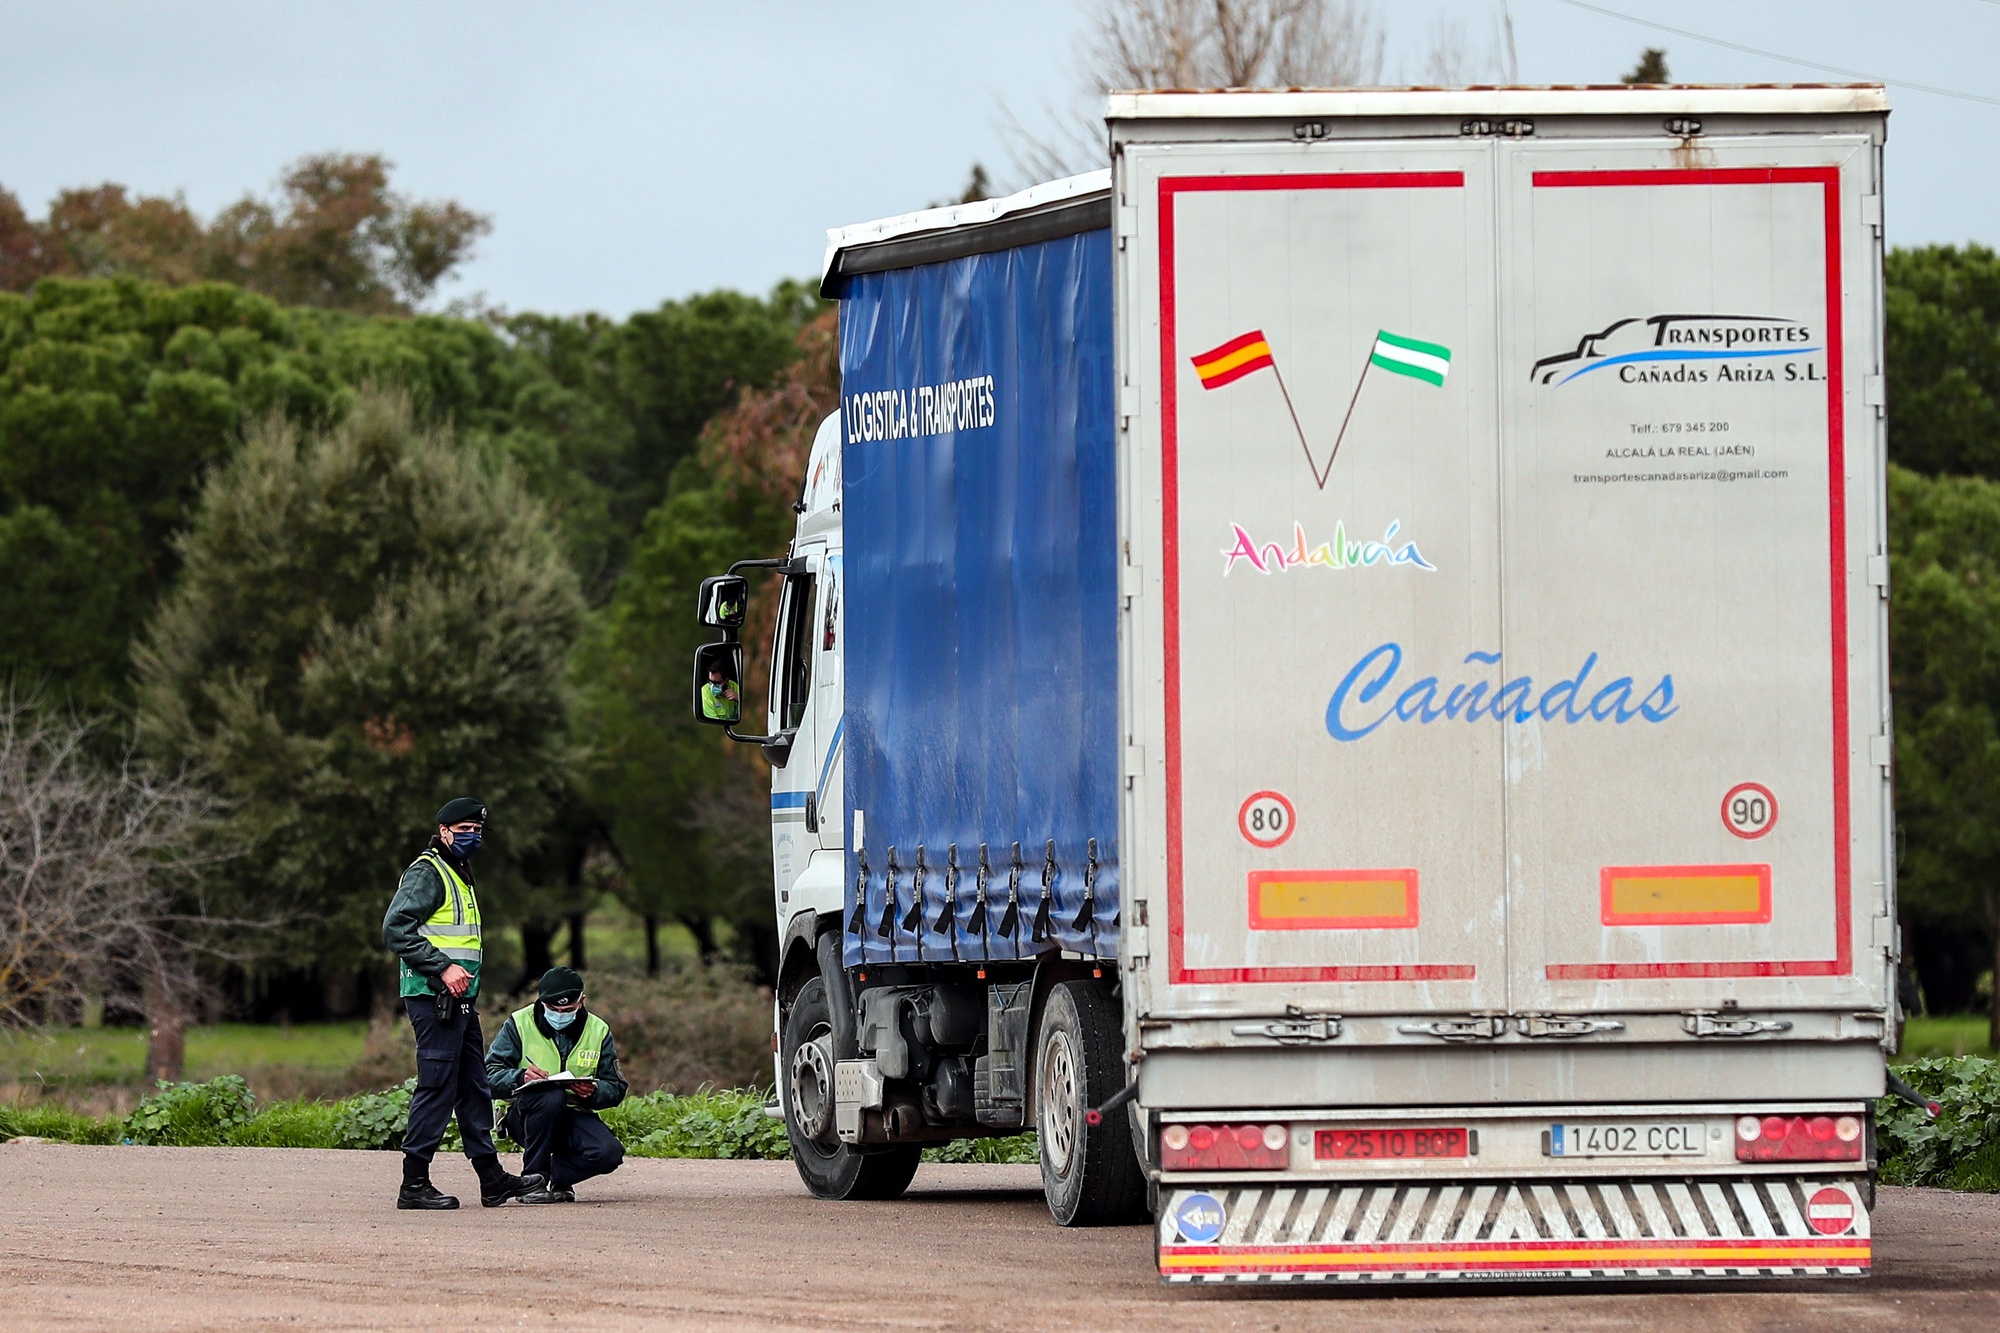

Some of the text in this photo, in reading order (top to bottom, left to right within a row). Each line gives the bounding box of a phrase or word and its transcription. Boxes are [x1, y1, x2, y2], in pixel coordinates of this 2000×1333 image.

[1784, 362, 1827, 382] S.L.
[845, 374, 995, 444] LOGISTICA & TRANSPORTES
[1662, 423, 1682, 433] 679
[1686, 422, 1706, 433] 345
[1710, 421, 1730, 432] 200
[1606, 443, 1755, 458] ALCALÁ LA REAL (JAÉN)
[1573, 469, 1788, 484] transportescanadasariza@gmail.com
[1325, 642, 1680, 741] Cañadas
[1252, 807, 1283, 831] 80
[1732, 797, 1767, 825] 90
[1320, 1131, 1461, 1157] R 2510 BCP
[1573, 1126, 1699, 1151] 1402 CCL
